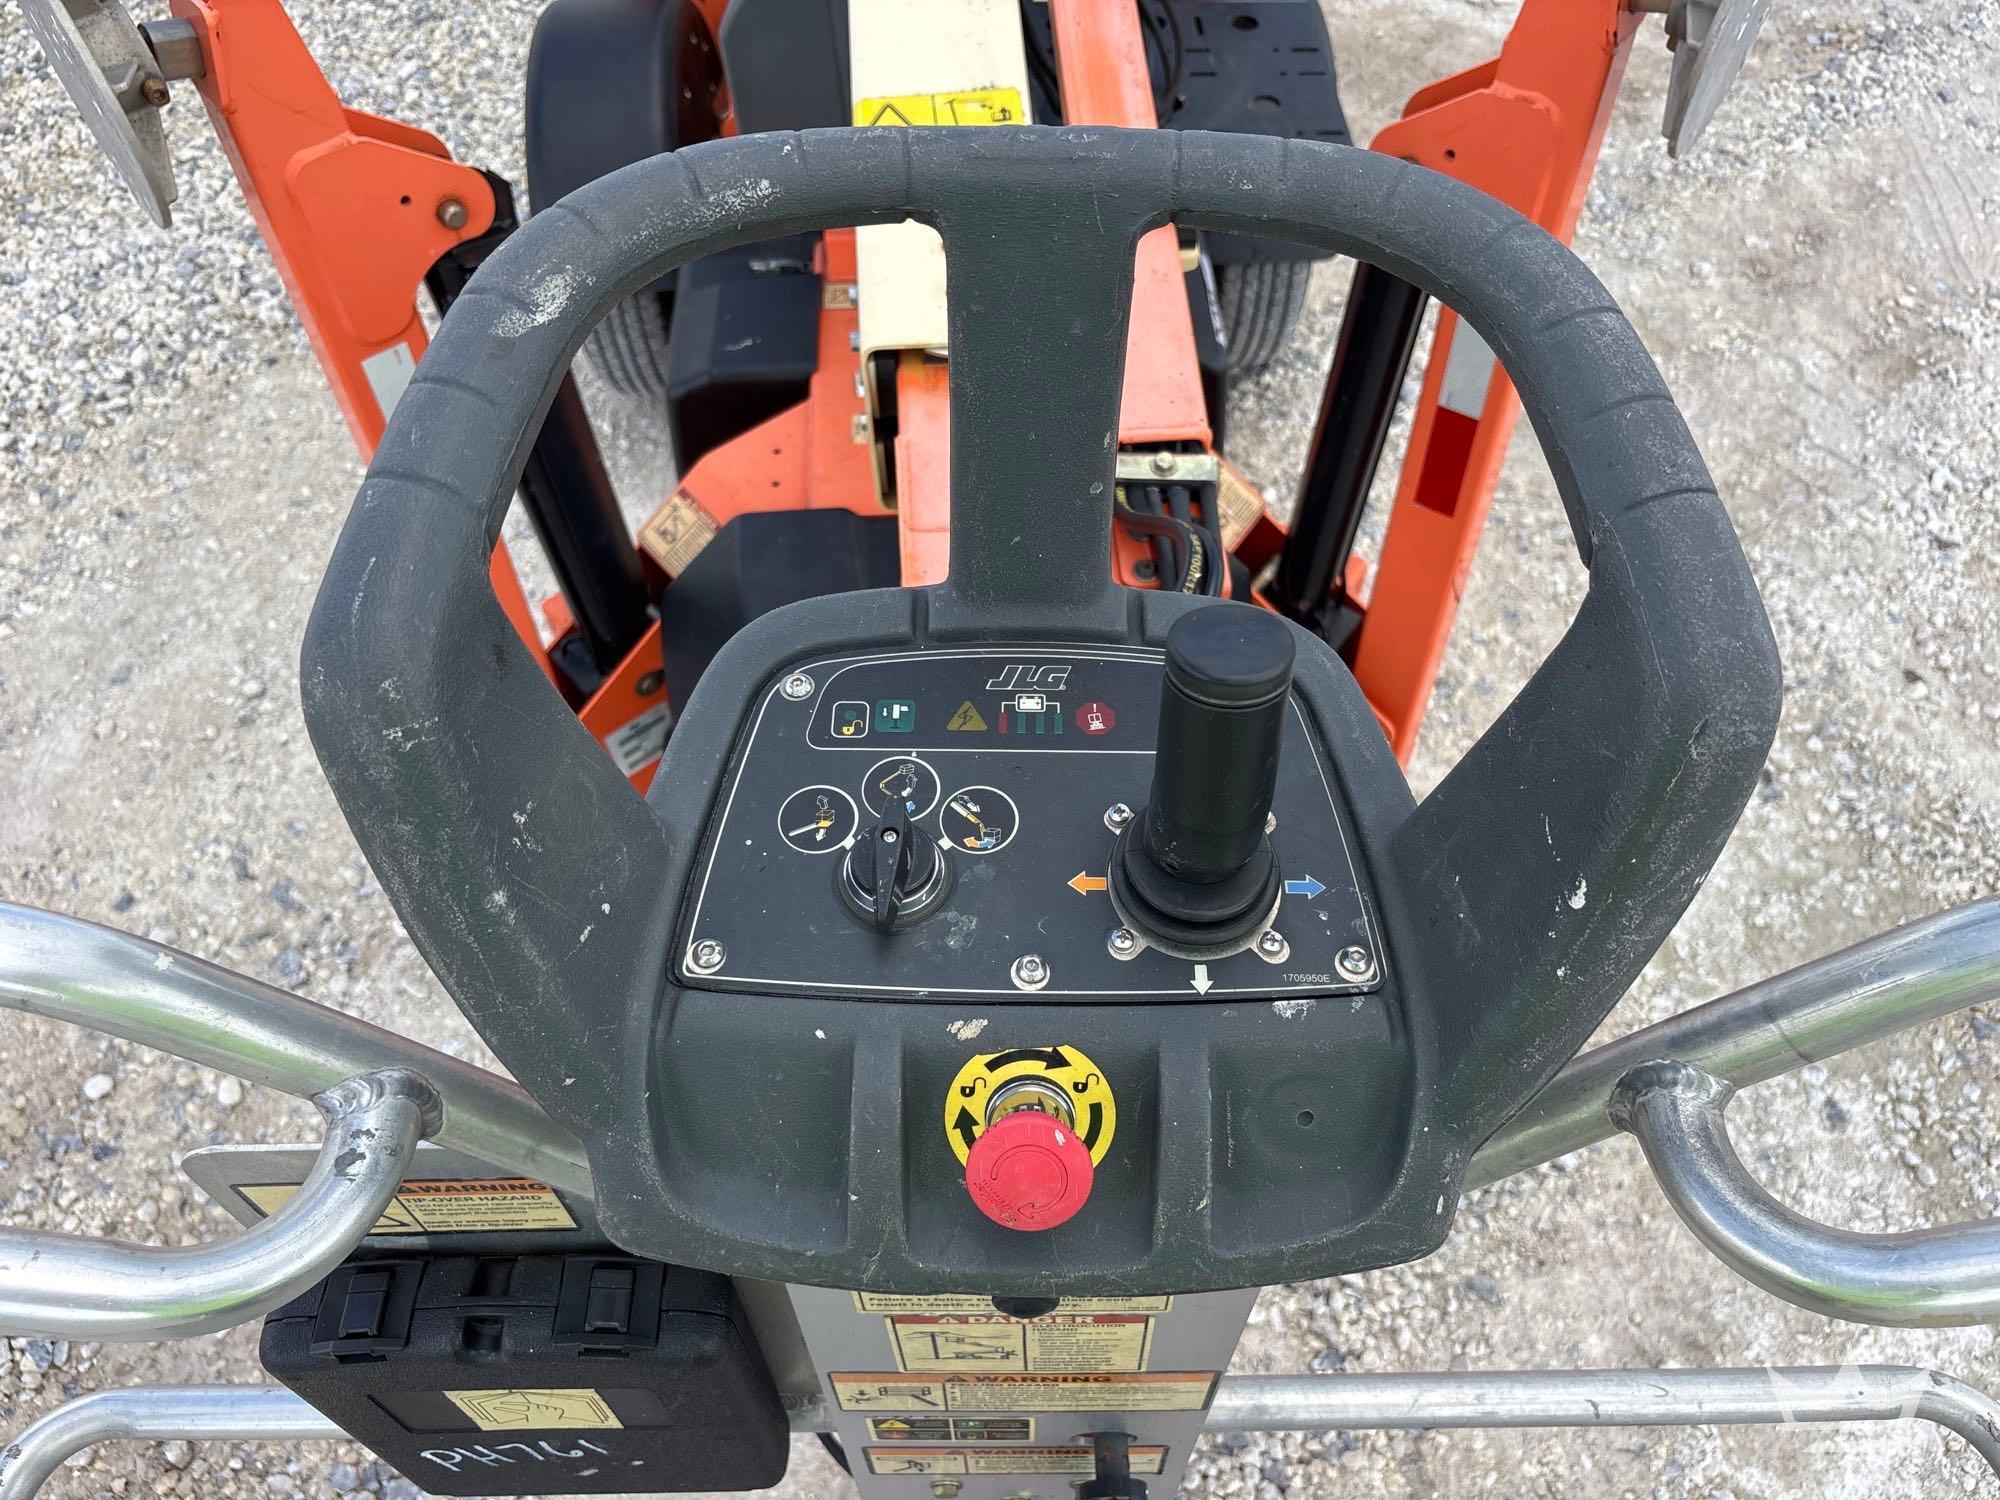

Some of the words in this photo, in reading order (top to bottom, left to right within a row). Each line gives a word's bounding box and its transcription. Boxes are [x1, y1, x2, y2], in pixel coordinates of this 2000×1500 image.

[985, 664, 1072, 691] JLG
[1282, 973, 1331, 983] 1705950E
[416, 1182, 548, 1193] WARNING
[404, 1196, 473, 1204] TIP-OVER
[479, 1195, 542, 1203] HAZARD
[966, 1315, 1096, 1324] DANGER
[974, 1375, 1112, 1383] WARNING
[419, 1438, 609, 1472] PH761
